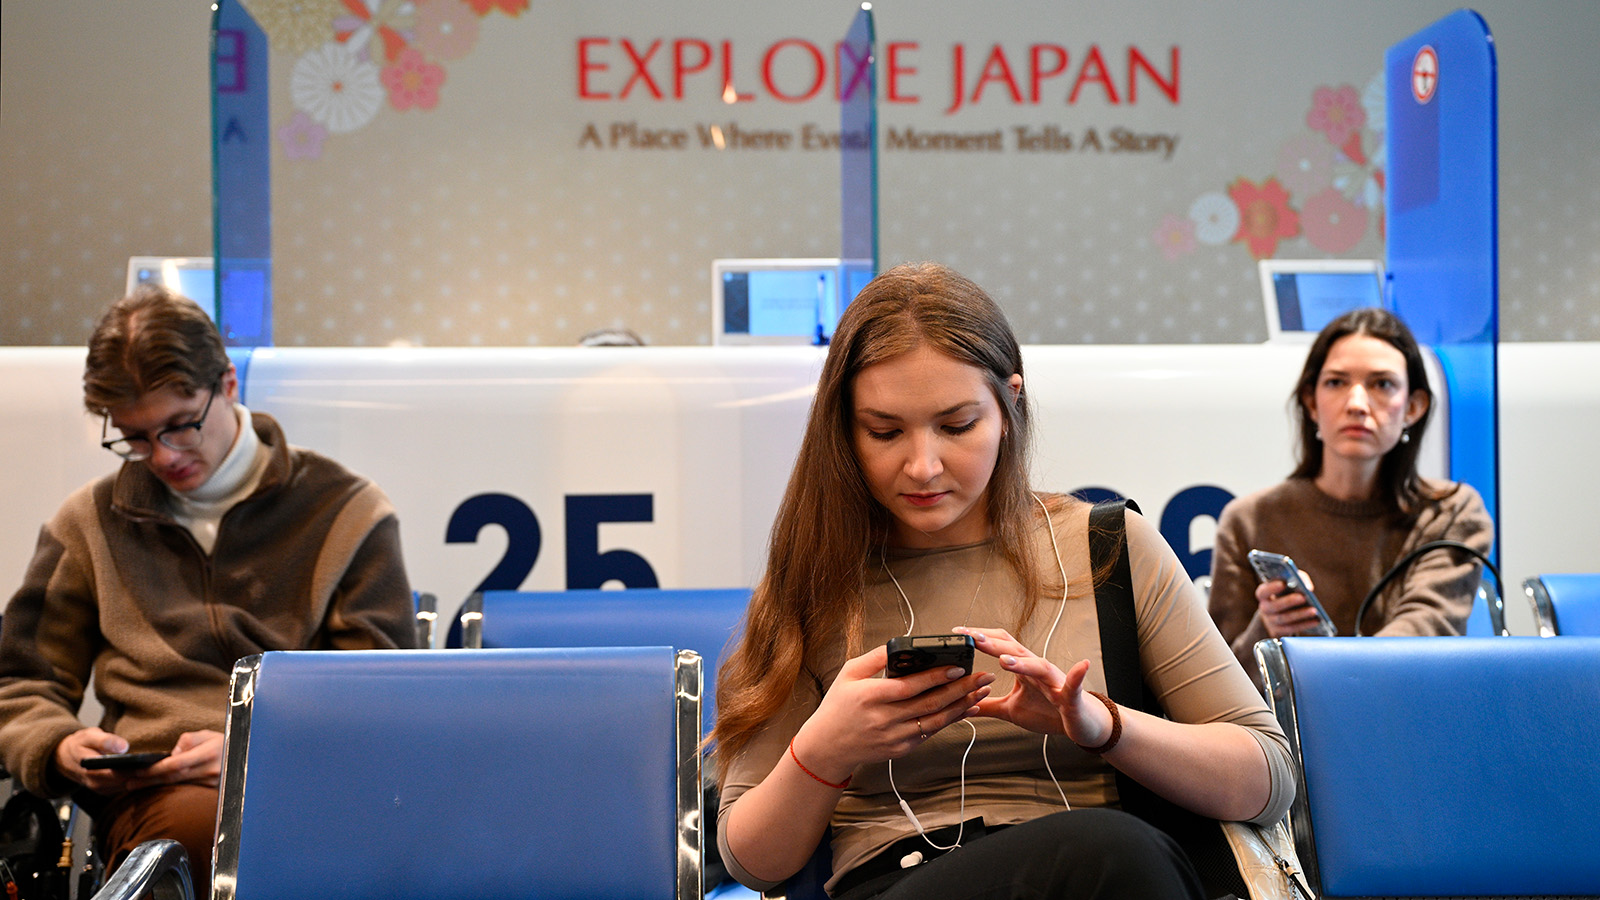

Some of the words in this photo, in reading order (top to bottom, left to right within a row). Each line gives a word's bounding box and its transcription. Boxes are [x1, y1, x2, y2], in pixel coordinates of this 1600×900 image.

[944, 42, 1181, 115] JAPAN
[579, 122, 602, 151] A
[609, 121, 688, 151] Place
[885, 125, 1003, 151] Moment
[1012, 126, 1073, 151] Tells
[1081, 127, 1103, 151] A
[1108, 127, 1180, 159] Story
[444, 492, 661, 649] 25
